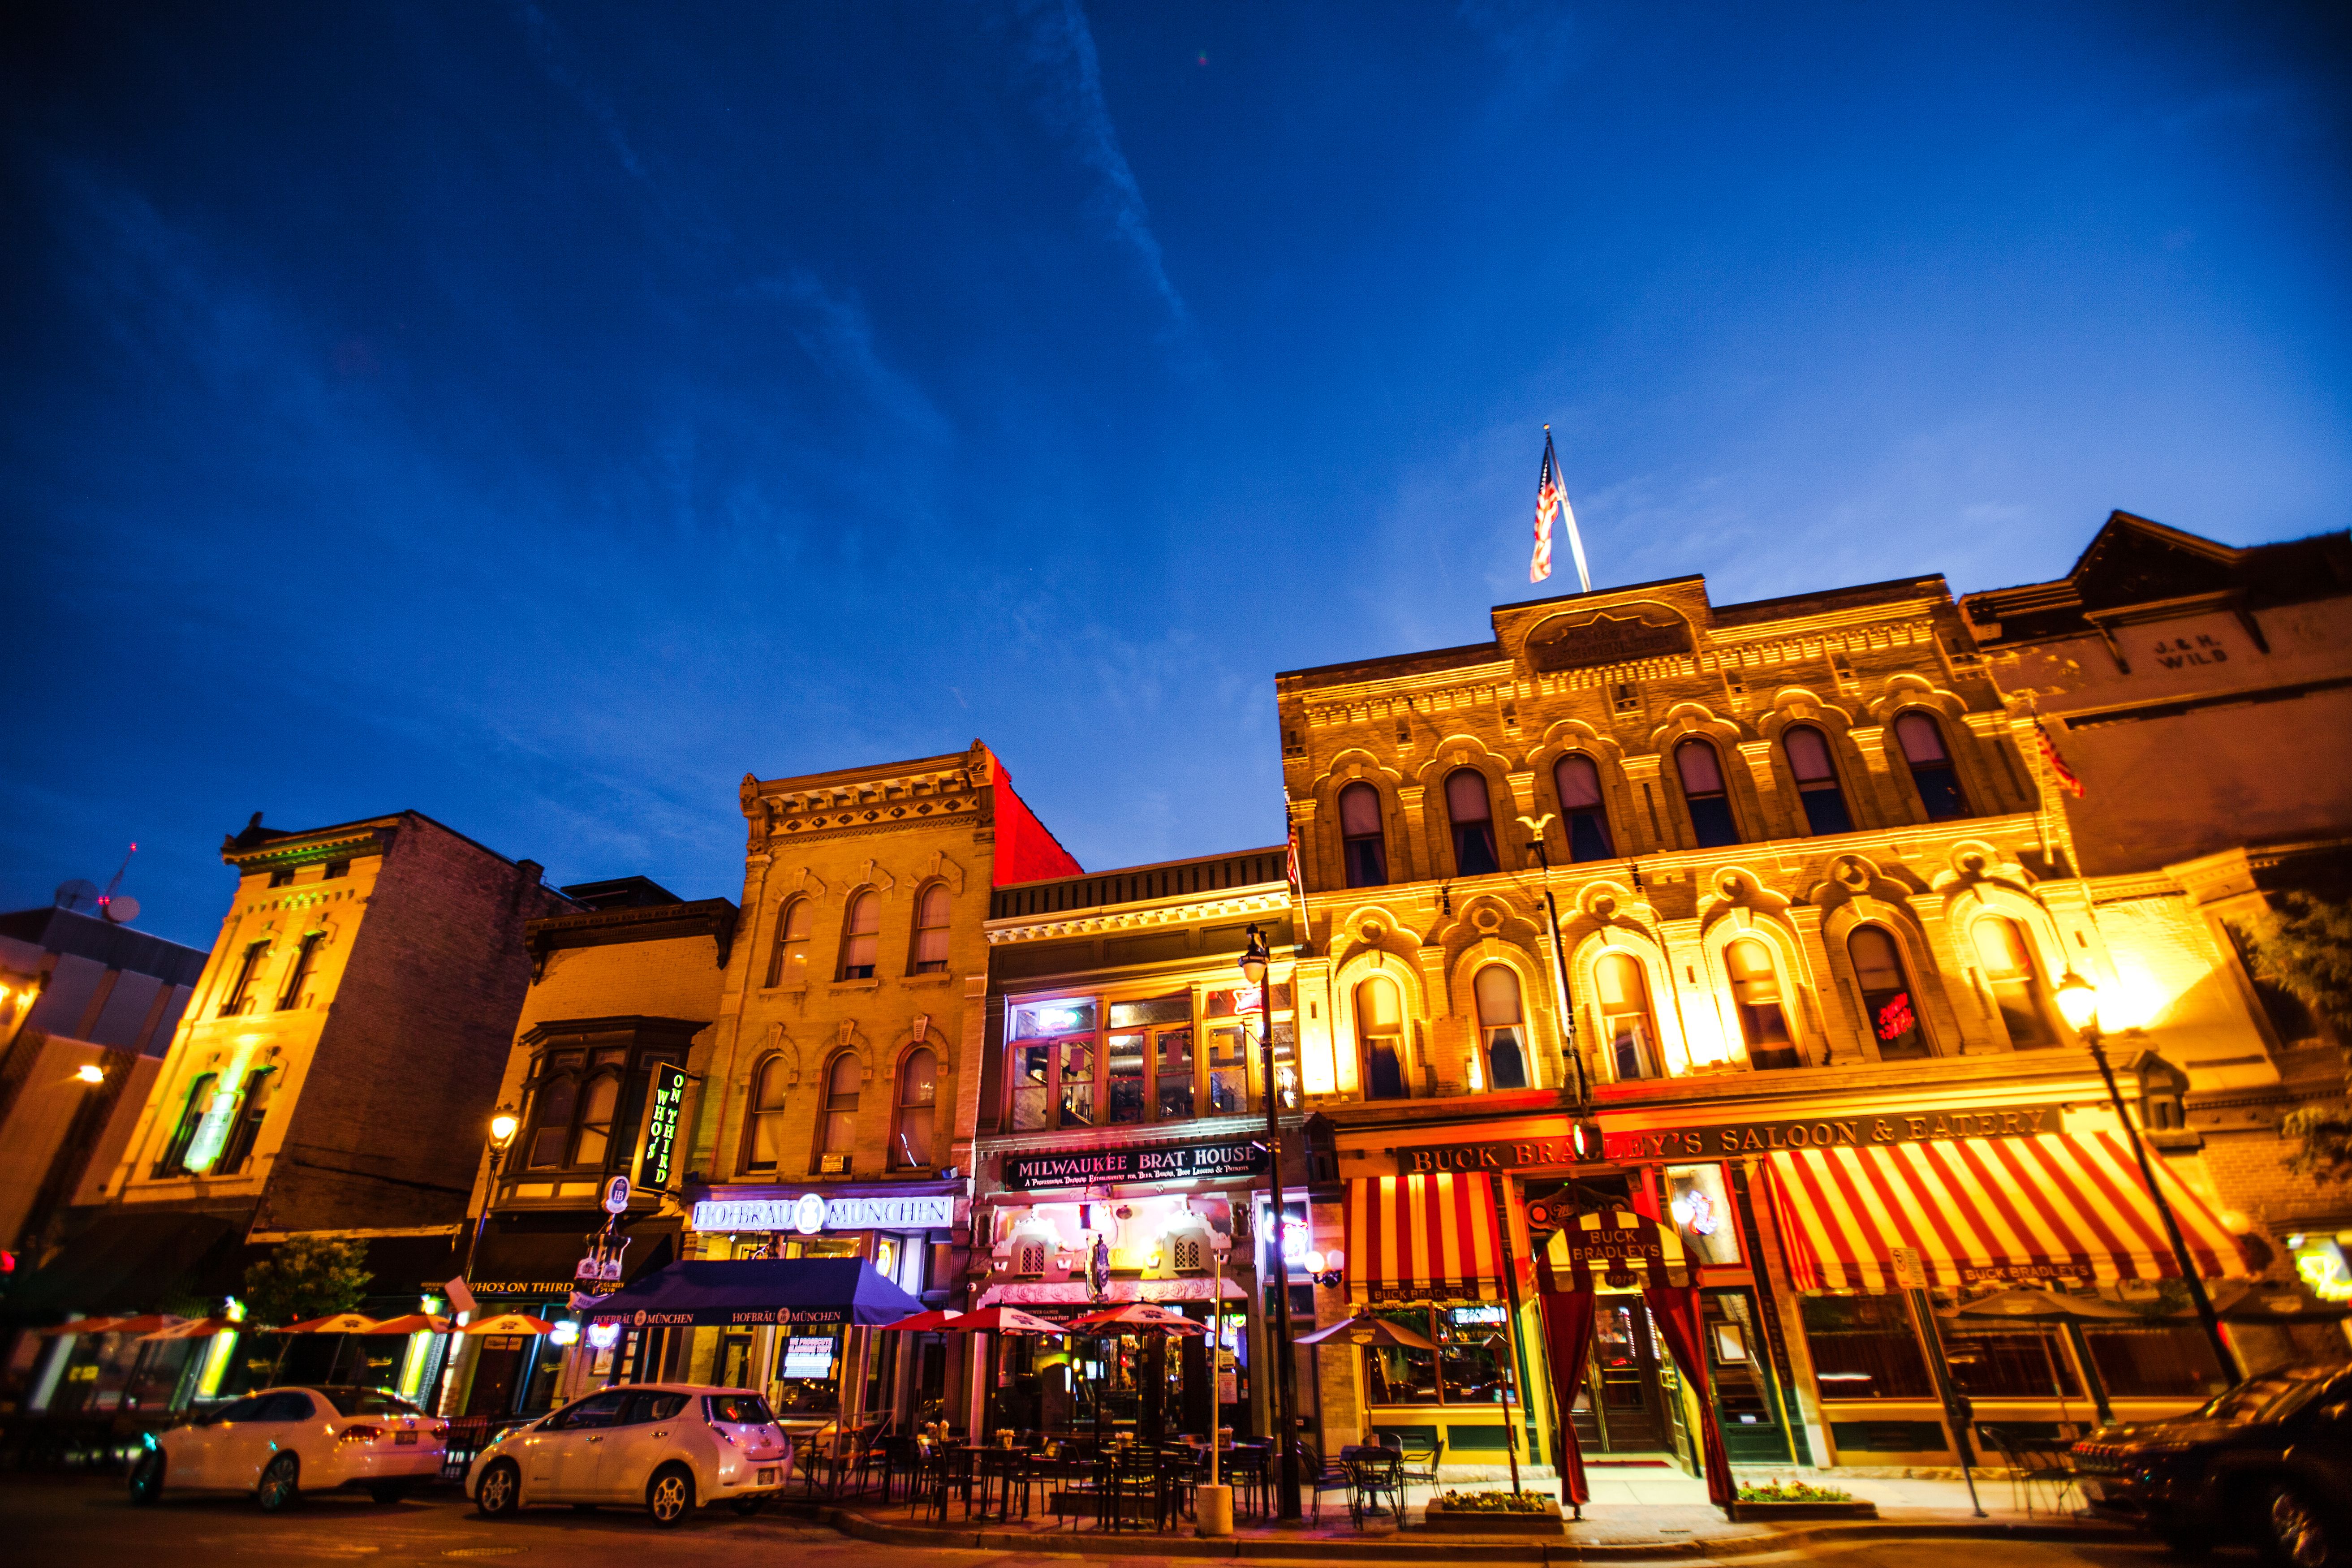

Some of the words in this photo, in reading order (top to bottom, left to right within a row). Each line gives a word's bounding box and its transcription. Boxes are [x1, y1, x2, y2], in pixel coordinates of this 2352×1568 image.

[2156, 649, 2227, 669] WILD
[670, 1074, 685, 1104] ON
[647, 1089, 670, 1160] WHO'S
[655, 1108, 678, 1184] THIRD
[1412, 1146, 1499, 1172] BUCK
[1513, 1132, 1702, 1164] BRALEY'S
[1721, 1121, 1858, 1151] SALOON
[1871, 1120, 1895, 1142] &
[1905, 1109, 2046, 1140] EATERY
[1019, 1154, 1128, 1177] MILWAUKEE
[1139, 1150, 1186, 1170] BRAT
[1195, 1146, 1256, 1166] HOUSE
[1591, 1230, 1637, 1244] BUCK
[1573, 1244, 1660, 1260] BRADLEY'S
[1964, 1267, 2006, 1280] BUCK
[507, 1283, 528, 1292] ON
[532, 1283, 574, 1292] THIRD
[1374, 1290, 1407, 1300] BUCK
[592, 1313, 633, 1324] HOFBRÄU
[646, 1313, 694, 1323] MÜNCHEN
[732, 1310, 776, 1322] HOFBRÄU
[791, 1310, 841, 1322] MÜNCHEN
